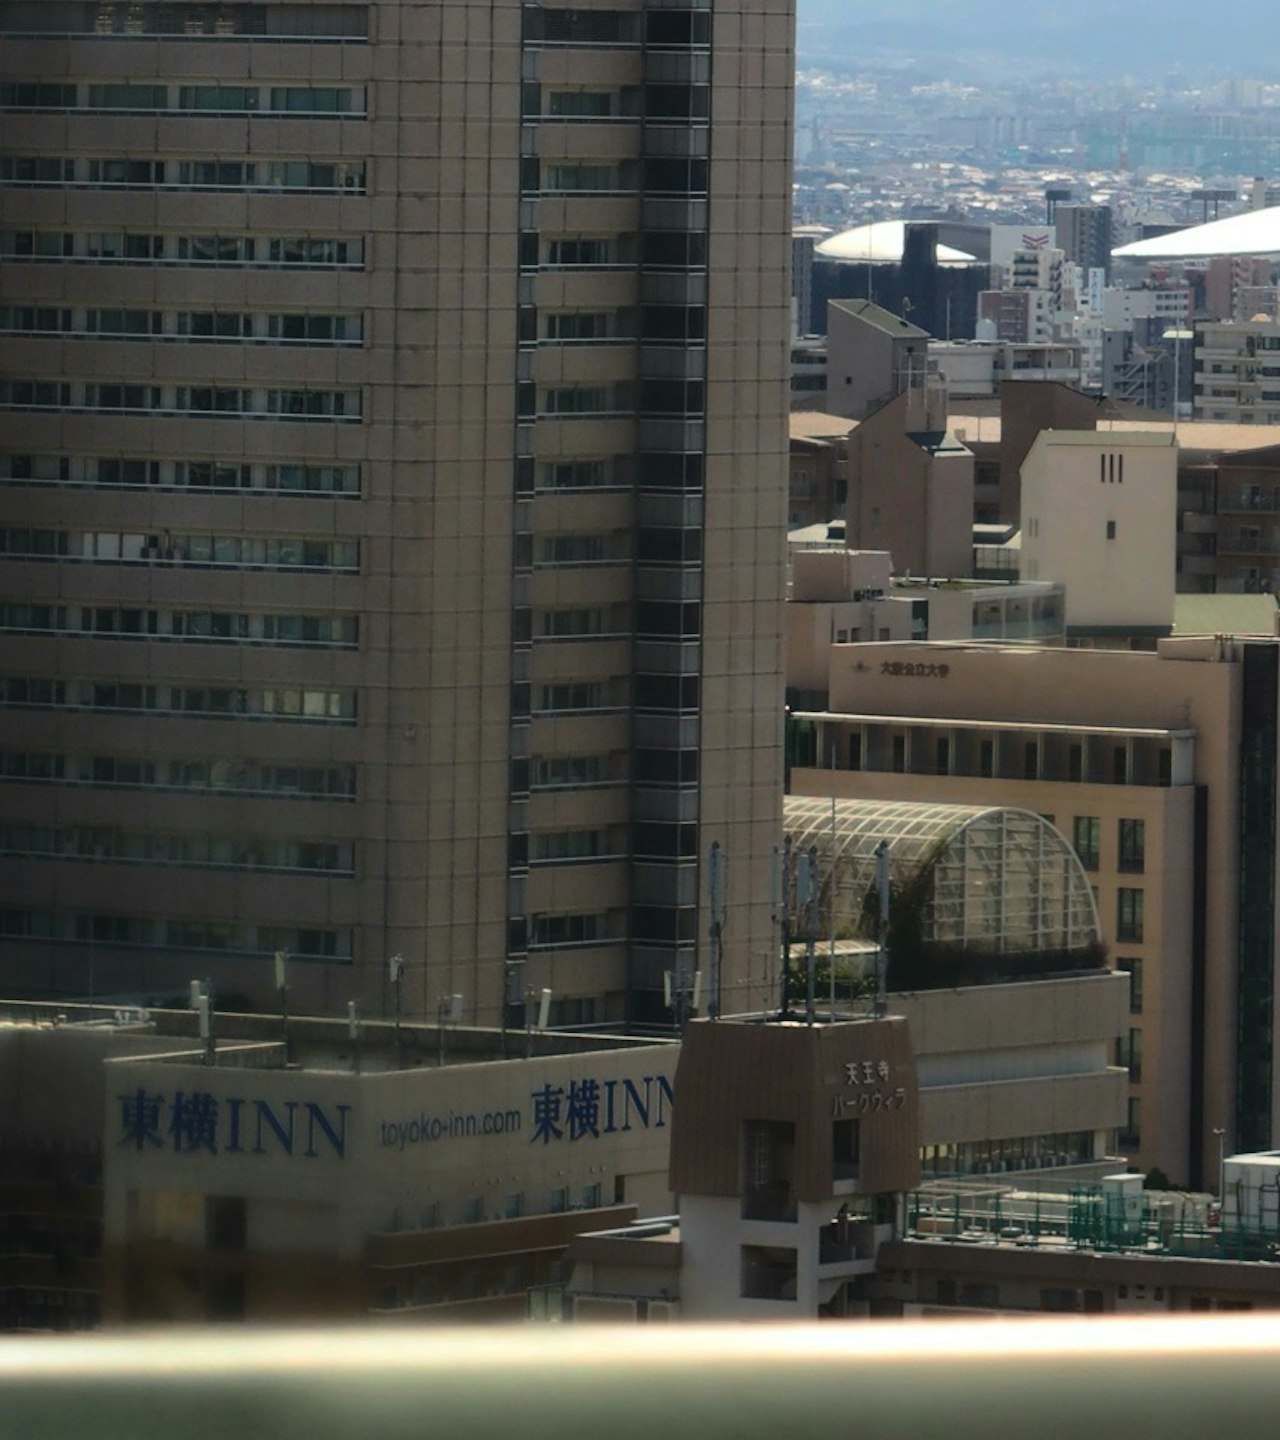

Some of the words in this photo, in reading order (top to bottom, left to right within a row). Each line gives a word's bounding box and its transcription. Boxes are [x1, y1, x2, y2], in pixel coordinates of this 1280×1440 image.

[845, 1060, 889, 1085] 天王寺
[117, 1088, 350, 1159] 東横INN
[381, 1110, 521, 1150] toyoko-inn.com
